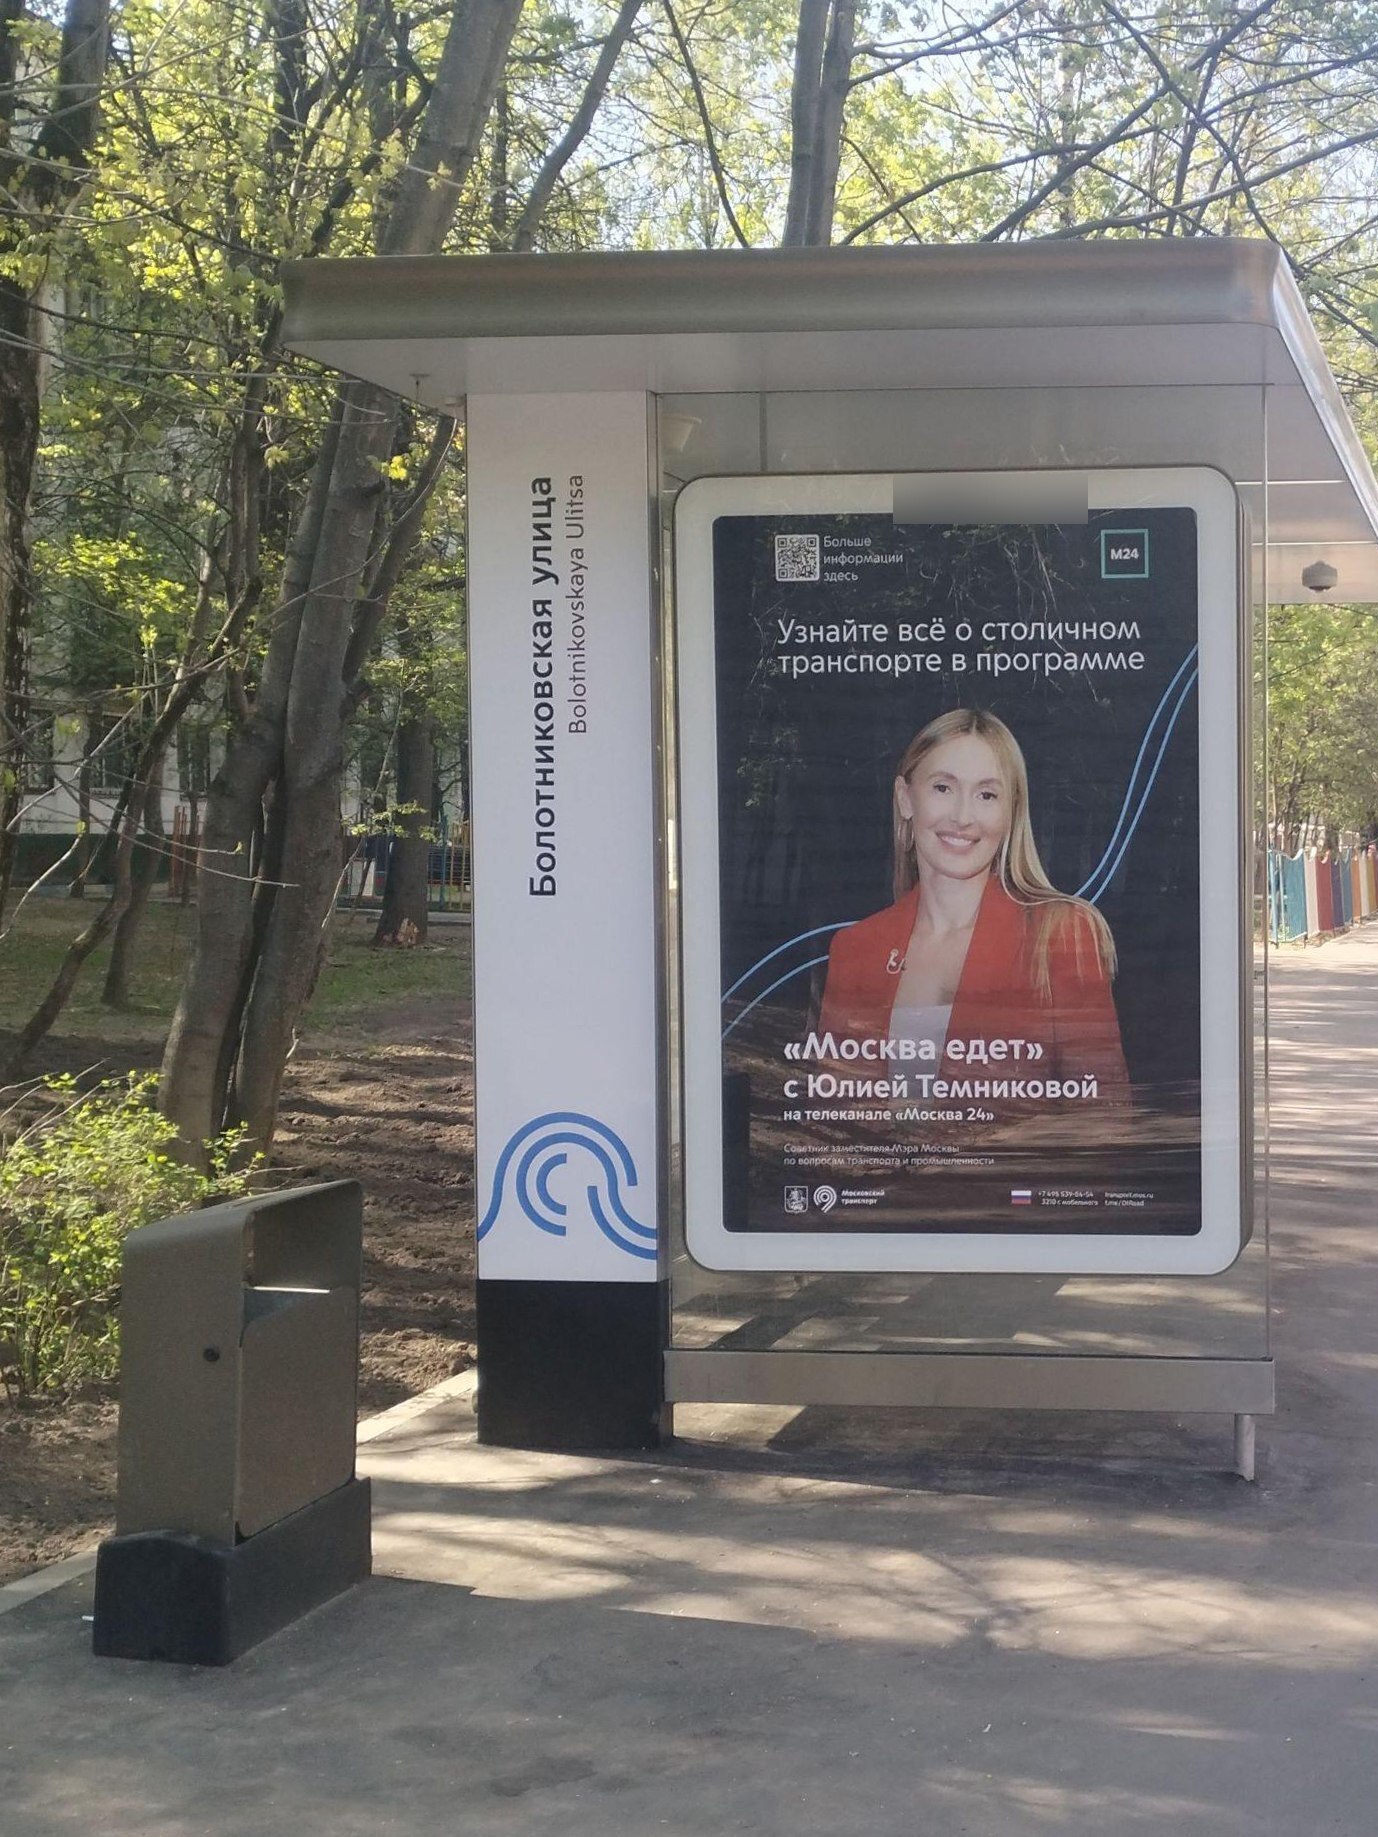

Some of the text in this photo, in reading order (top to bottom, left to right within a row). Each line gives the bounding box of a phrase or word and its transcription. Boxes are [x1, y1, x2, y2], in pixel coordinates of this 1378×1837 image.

[823, 536, 872, 548] Больше
[823, 553, 904, 567] информации
[823, 571, 859, 583] здесь
[566, 474, 589, 734] Bolotnikovskaya Ulitsa
[777, 617, 1141, 645] Узнайте всё о столичном
[778, 652, 1145, 679] транспорте в программе
[529, 475, 560, 897] Болотниковская улица
[784, 1032, 1043, 1064] «Москва едет»
[784, 1073, 1097, 1098] с Юлией Темниковой
[784, 1108, 994, 1122] на телеканале «Москва 24»
[784, 1144, 959, 1154] Советник заместителя Мэра Москвы
[798, 1157, 845, 1166] вопросам
[847, 1157, 900, 1166] транспорта
[911, 1157, 994, 1166] промышленности
